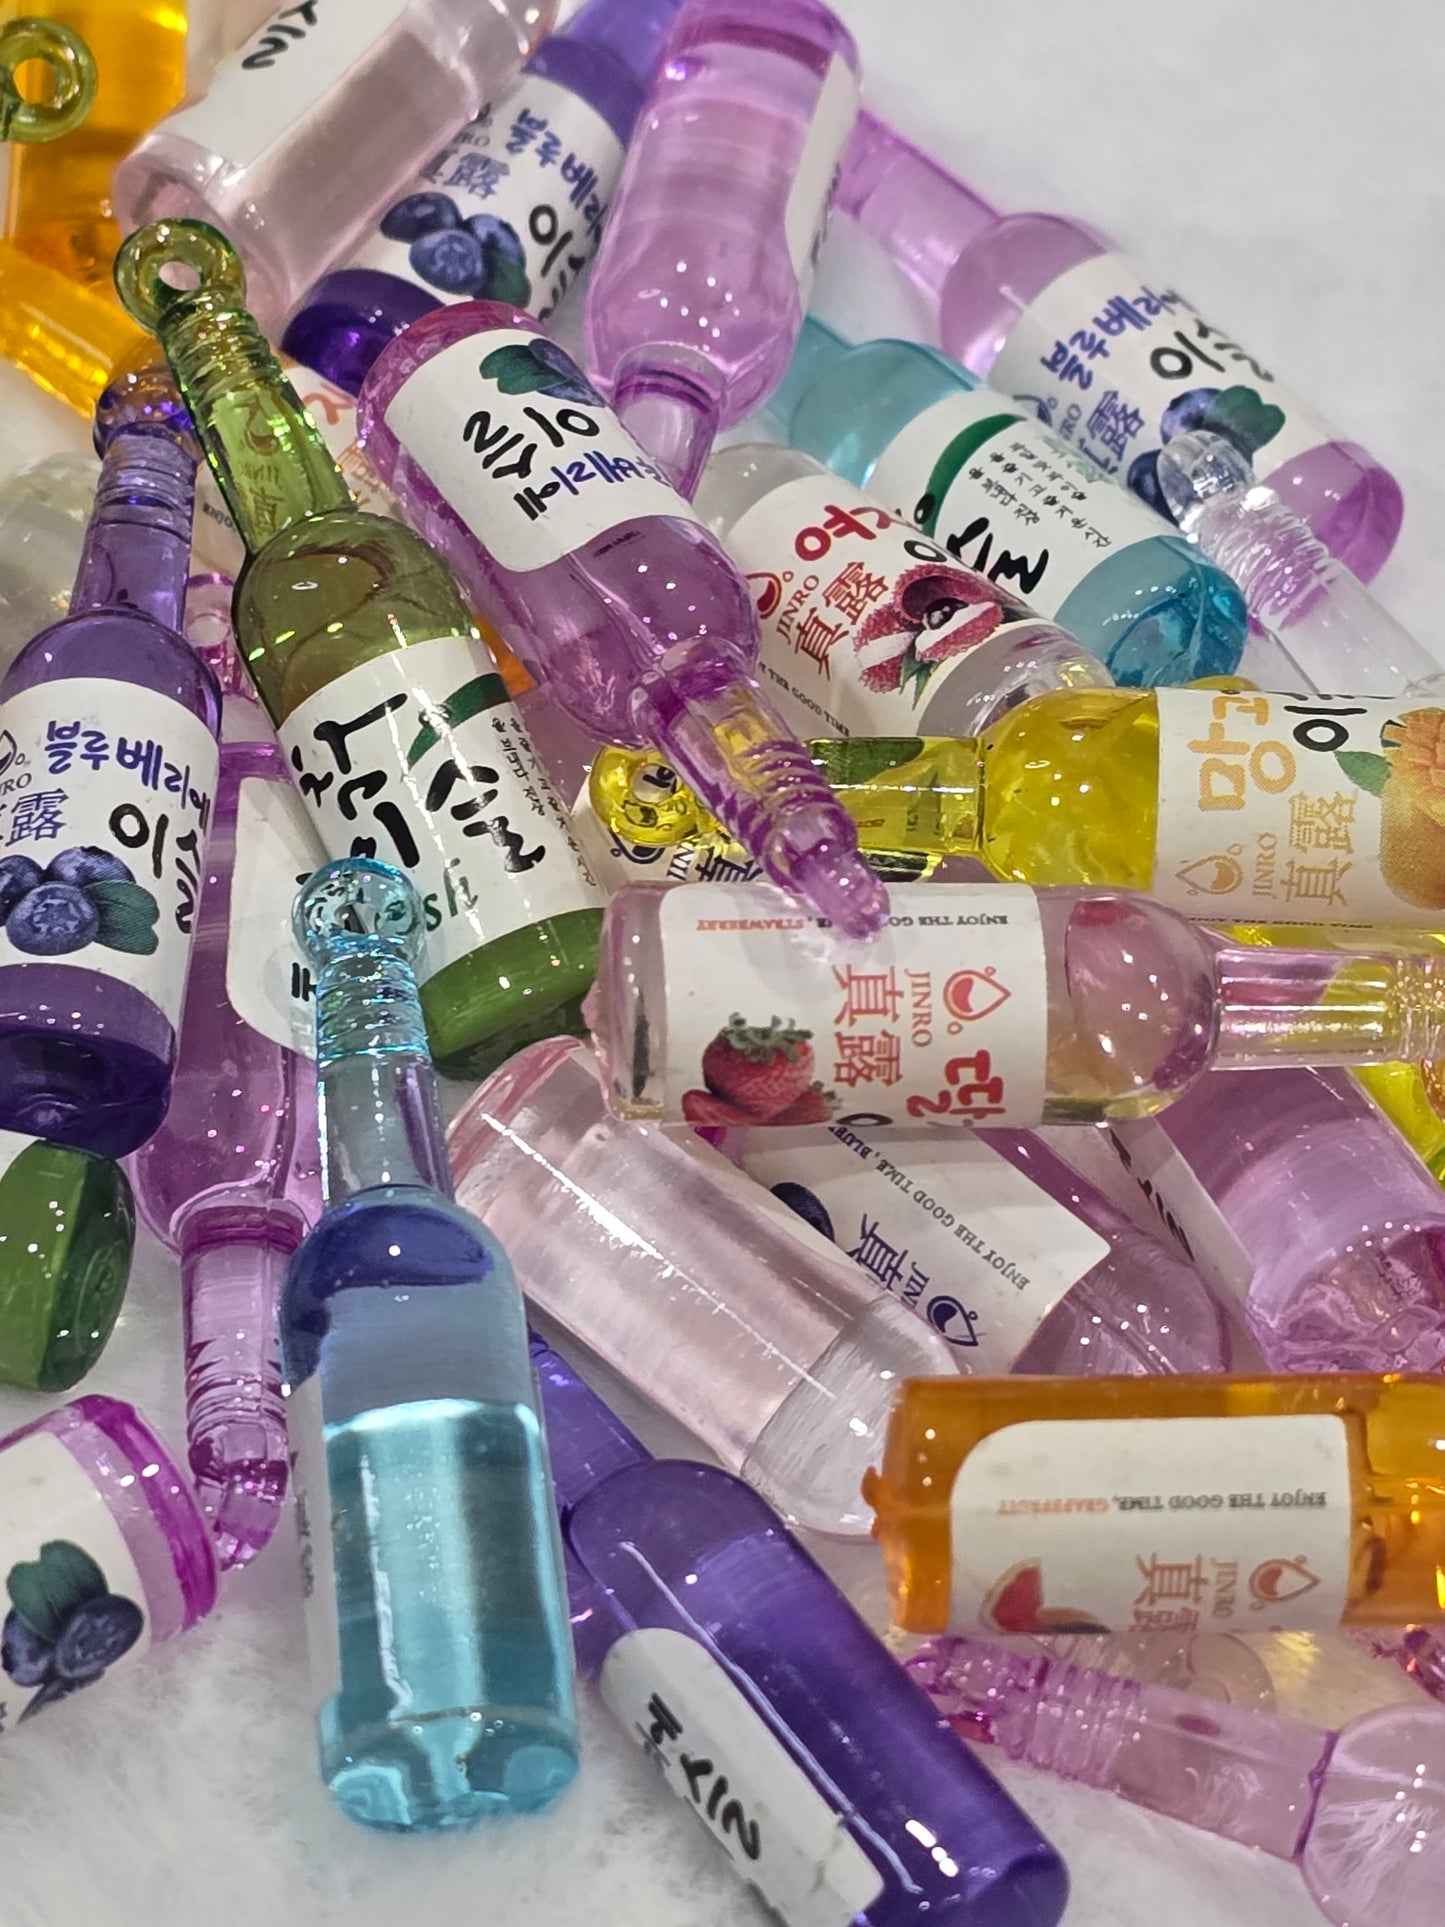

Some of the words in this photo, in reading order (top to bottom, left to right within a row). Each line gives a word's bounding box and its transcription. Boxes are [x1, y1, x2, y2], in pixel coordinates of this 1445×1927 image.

[463, 406, 600, 479] 이슬
[776, 573, 820, 646] JINRO
[795, 561, 890, 682] 真露
[0, 787, 70, 848] 露
[1280, 789, 1358, 907] 真露
[1252, 832, 1279, 900] JINRO
[918, 915, 955, 927] THE
[956, 913, 1008, 927] ENJOY
[831, 962, 905, 1088] 真露
[904, 967, 934, 1049] JINRO
[912, 1188, 957, 1229] GOOD
[845, 1212, 910, 1293] 真
[953, 1223, 987, 1256] THE
[900, 1260, 931, 1308] JIN
[982, 1250, 1032, 1291] ENJOY
[1168, 1494, 1224, 1510] GOOD
[1228, 1491, 1267, 1509] THE
